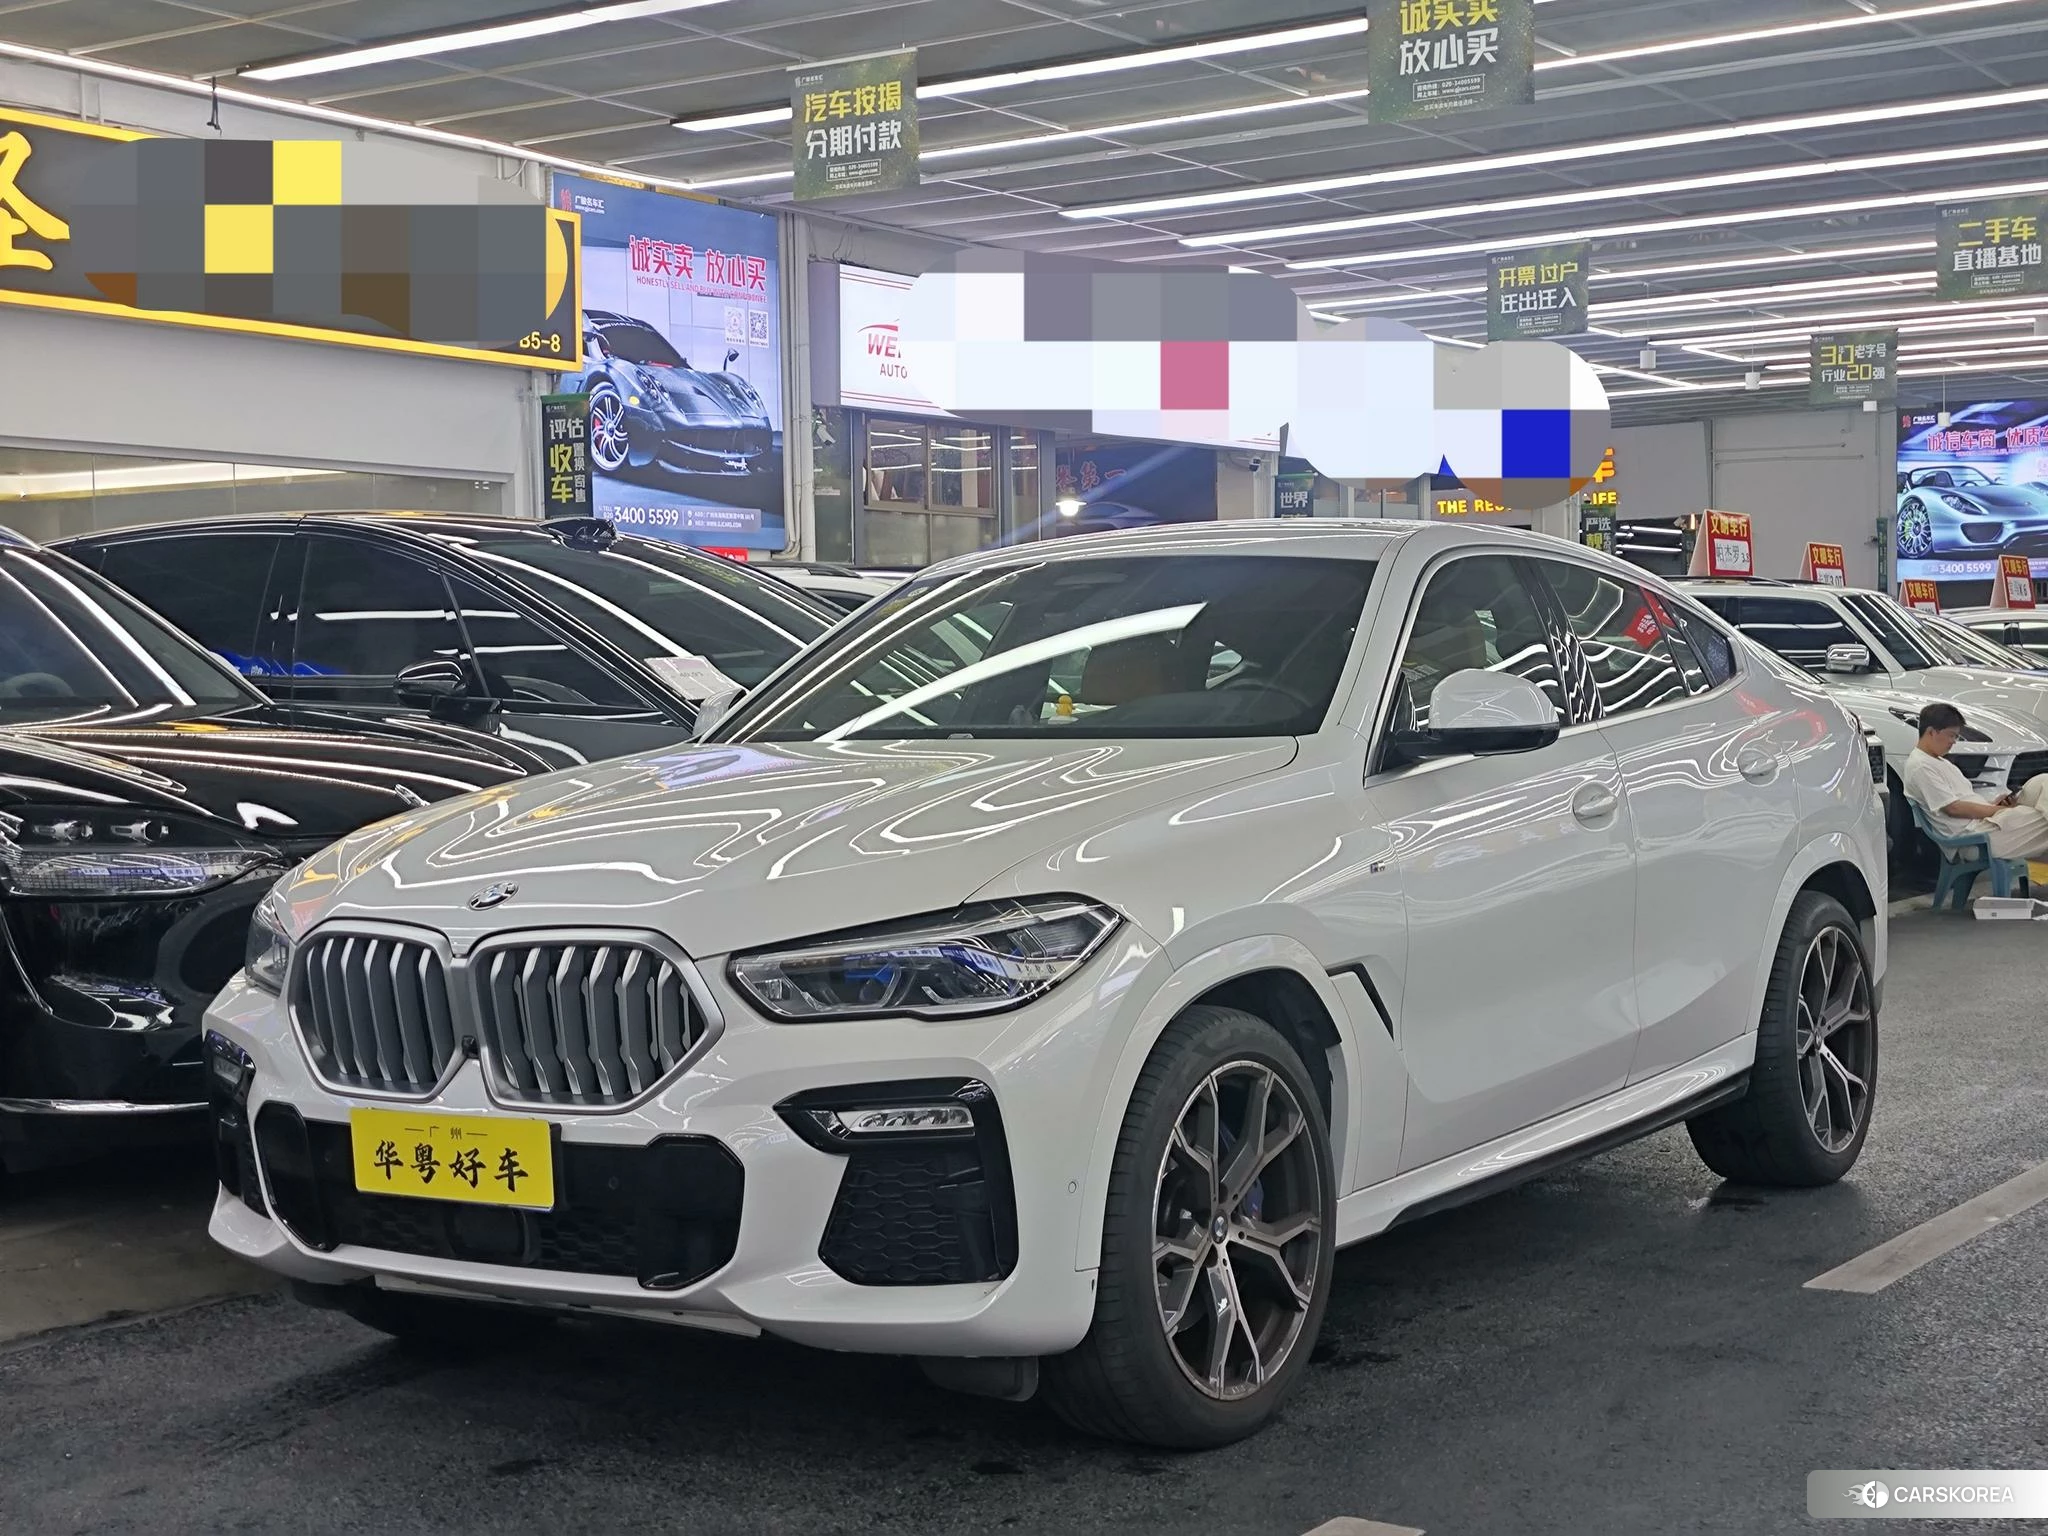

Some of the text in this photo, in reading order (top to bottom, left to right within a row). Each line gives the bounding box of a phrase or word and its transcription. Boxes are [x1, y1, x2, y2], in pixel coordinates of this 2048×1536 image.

[1400, 27, 1498, 76] 放心买
[805, 80, 902, 123] 汽车按揭
[805, 119, 902, 160] 分期付款
[1958, 216, 2037, 247] 二手车
[629, 234, 768, 292] 诚实卖 放心买
[1953, 243, 2042, 272] 直播基地
[636, 276, 670, 288] HONESTLY
[1499, 261, 1578, 289] 开票 过户
[868, 333, 901, 358] WE
[880, 363, 908, 379] AUTO
[549, 417, 585, 440] 评估
[1927, 429, 1996, 452] 诚信车商
[549, 443, 574, 504] 收车
[1280, 491, 1308, 509] 世界
[1437, 499, 1468, 515] THE
[613, 506, 645, 525] 3400
[648, 508, 679, 527] 5599
[1586, 517, 1611, 531] 严选
[1711, 514, 1749, 538] 文明车行
[1812, 546, 1841, 567] 文明车行
[2003, 558, 2028, 576] 文明车行
[1939, 563, 1965, 575] 3400
[1966, 562, 1992, 573] 5599
[1908, 582, 1936, 600] 文明车行
[429, 1125, 462, 1140] 广州
[374, 1139, 529, 1193] 华粤好车
